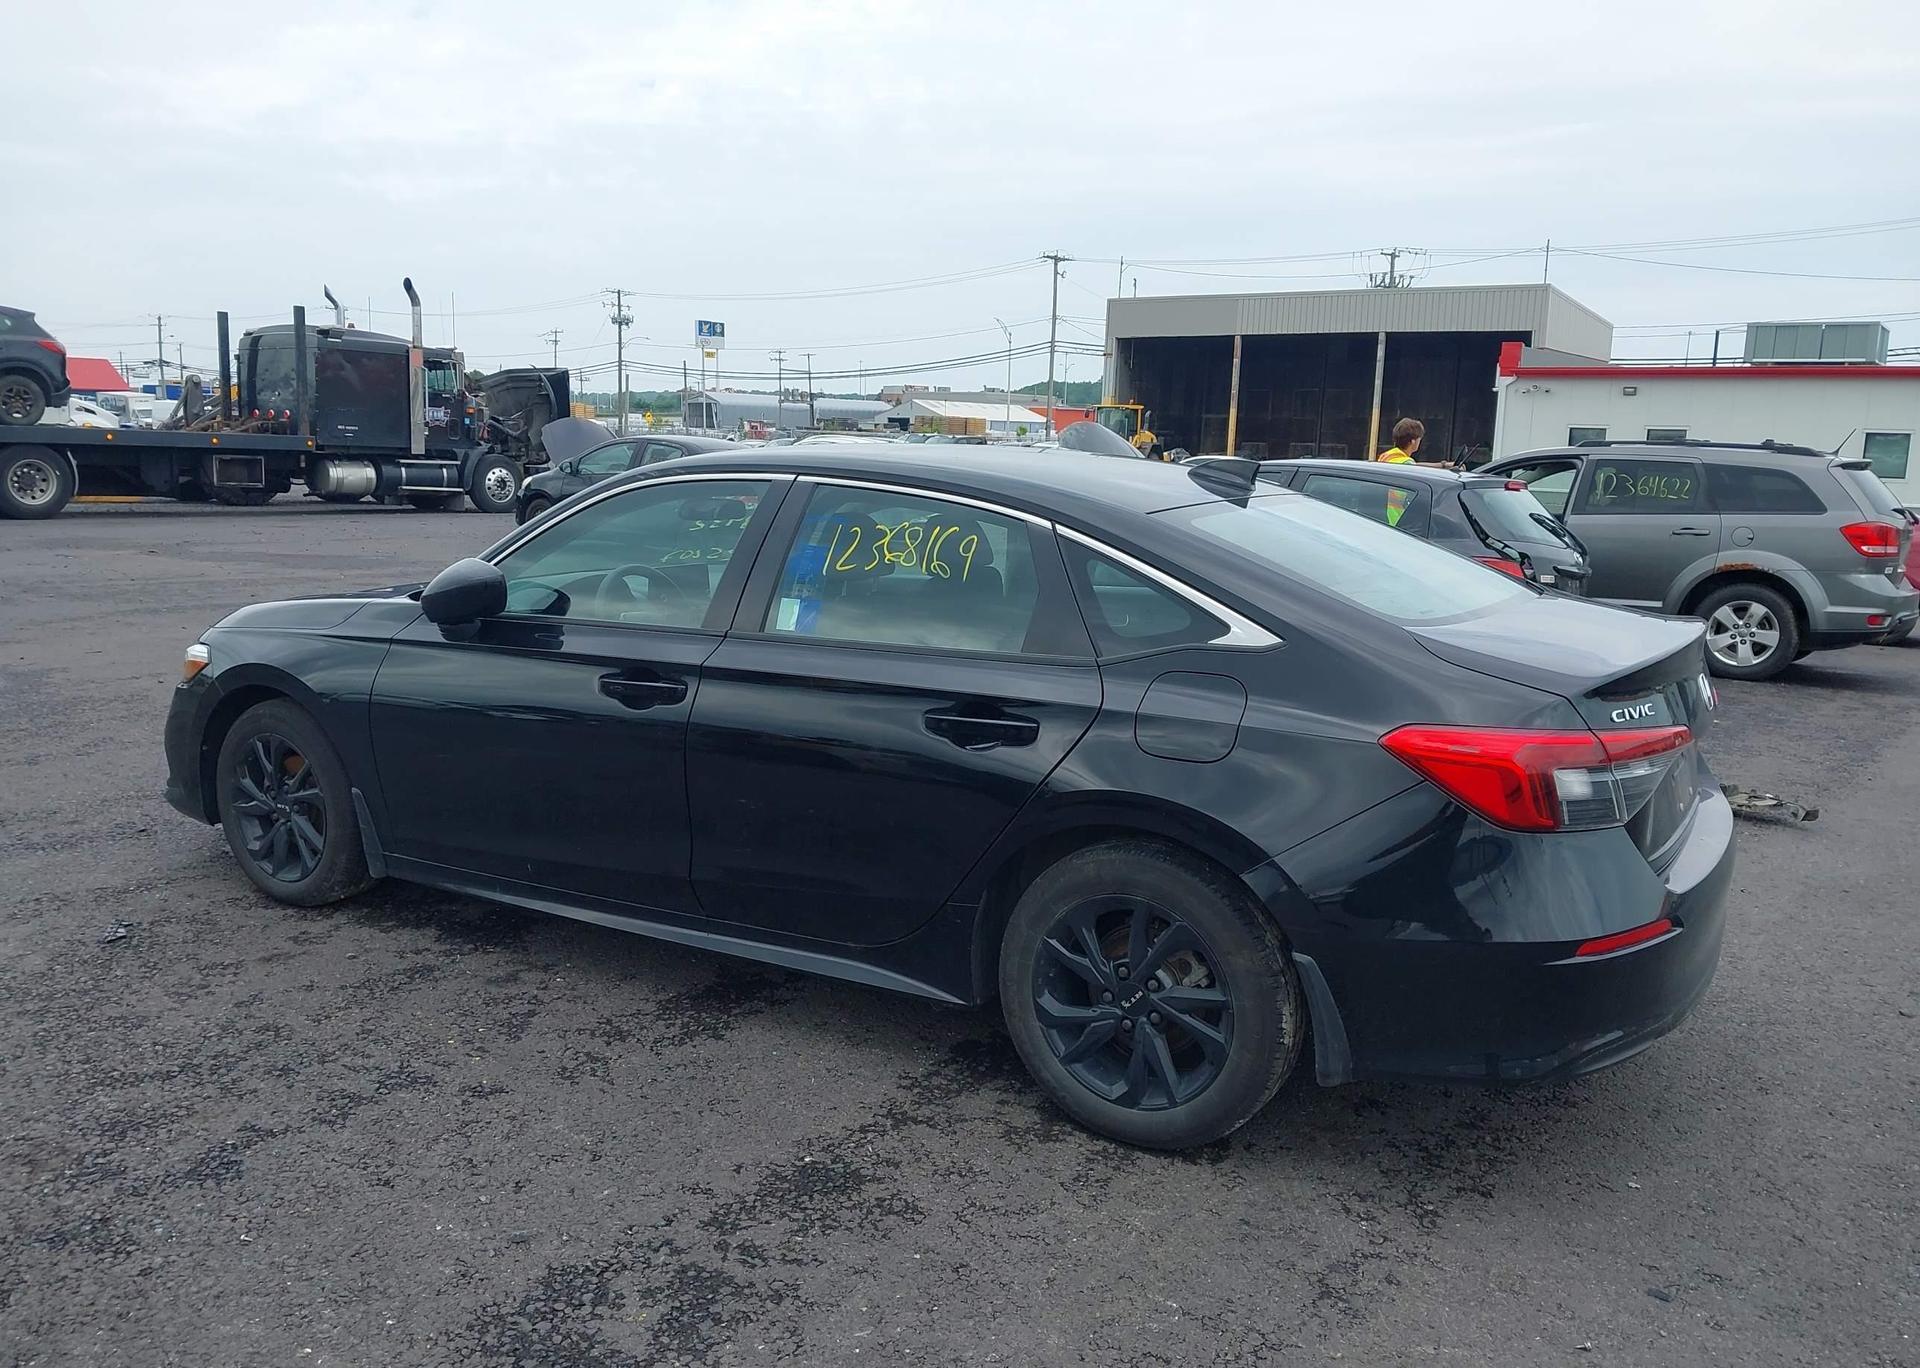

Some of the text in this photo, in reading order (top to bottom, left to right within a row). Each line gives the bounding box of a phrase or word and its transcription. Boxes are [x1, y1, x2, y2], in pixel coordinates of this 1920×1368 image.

[1597, 472, 1691, 500] 12364622
[822, 521, 978, 583] 12368169
[1611, 703, 1656, 723] CIVIC
